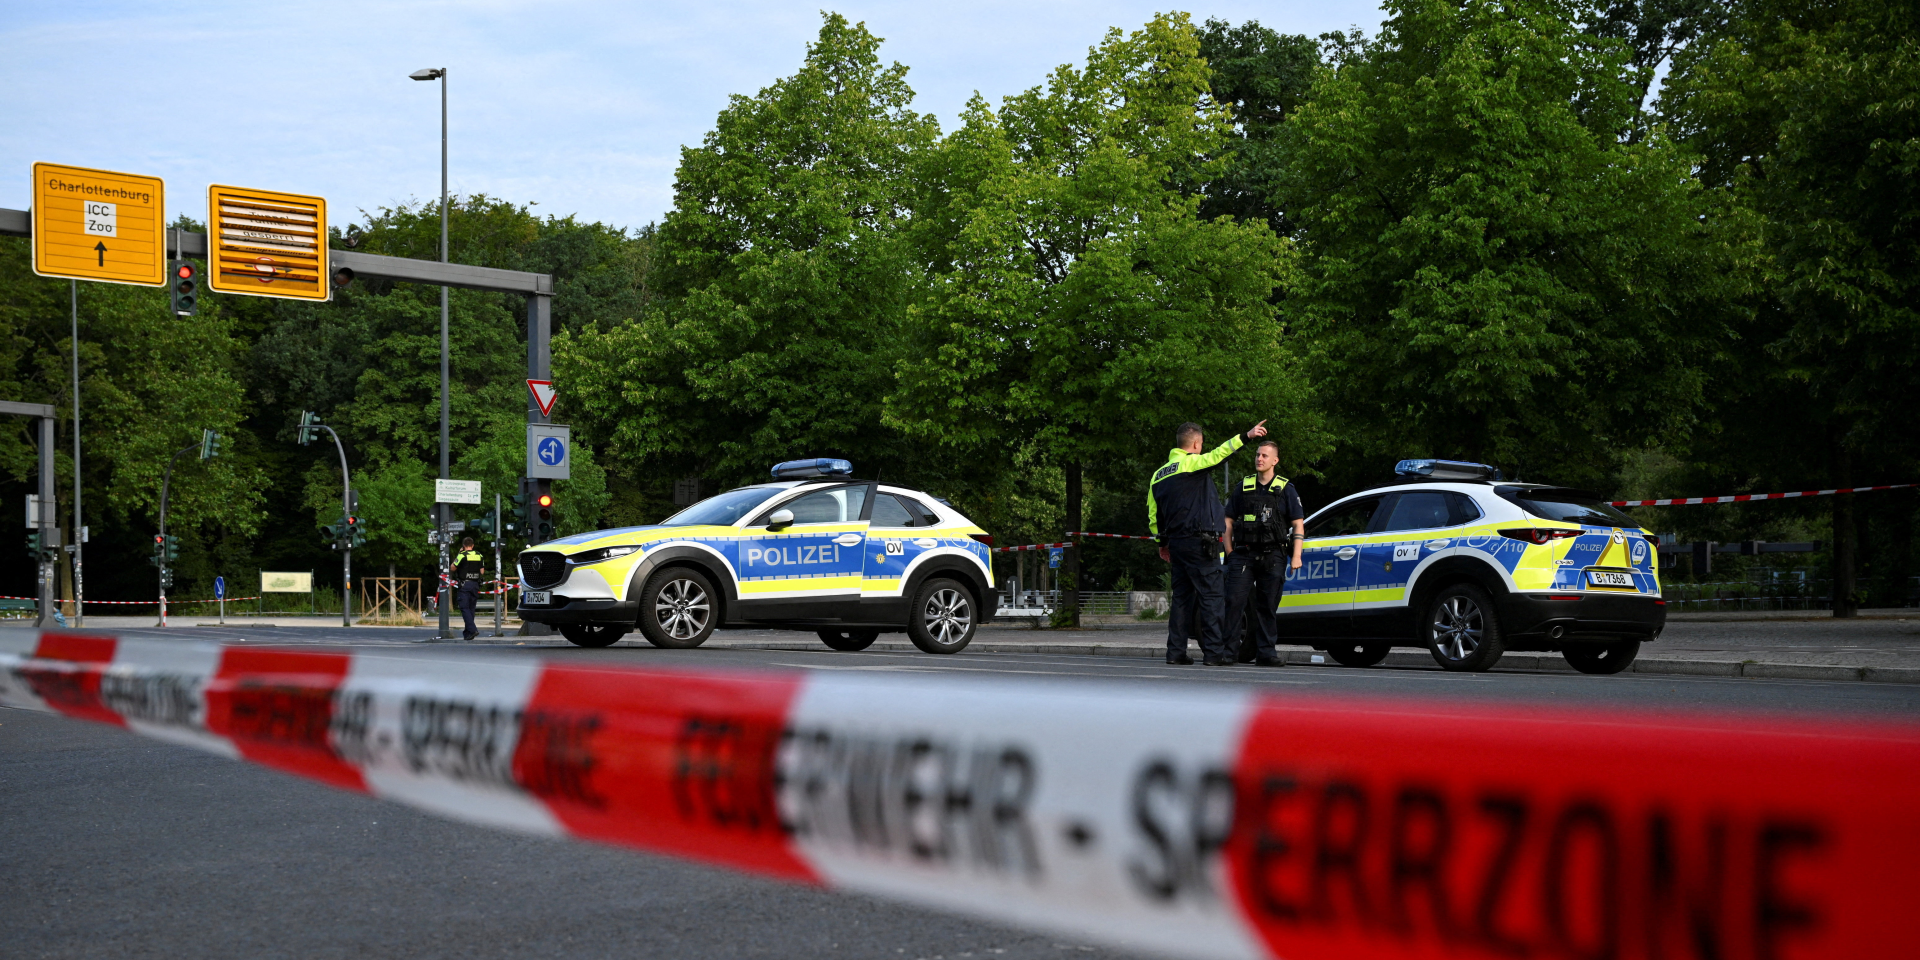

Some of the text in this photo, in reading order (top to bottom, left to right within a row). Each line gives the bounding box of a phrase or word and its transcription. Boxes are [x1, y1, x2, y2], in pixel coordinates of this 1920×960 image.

[49, 178, 149, 204] Charlottenburg
[88, 203, 110, 217] ICC
[88, 219, 113, 233] Zoo
[886, 542, 902, 554] OV
[1396, 548, 1418, 557] OV 1
[1503, 541, 1525, 553] 110
[1575, 543, 1603, 552] POLIZEI
[747, 544, 840, 567] POLIZEI
[1284, 559, 1339, 582] OLIZEI
[1595, 572, 1626, 585] B 7368
[672, 716, 1045, 884] FEUERWEHR
[1127, 756, 1833, 960] SPERRZONE
